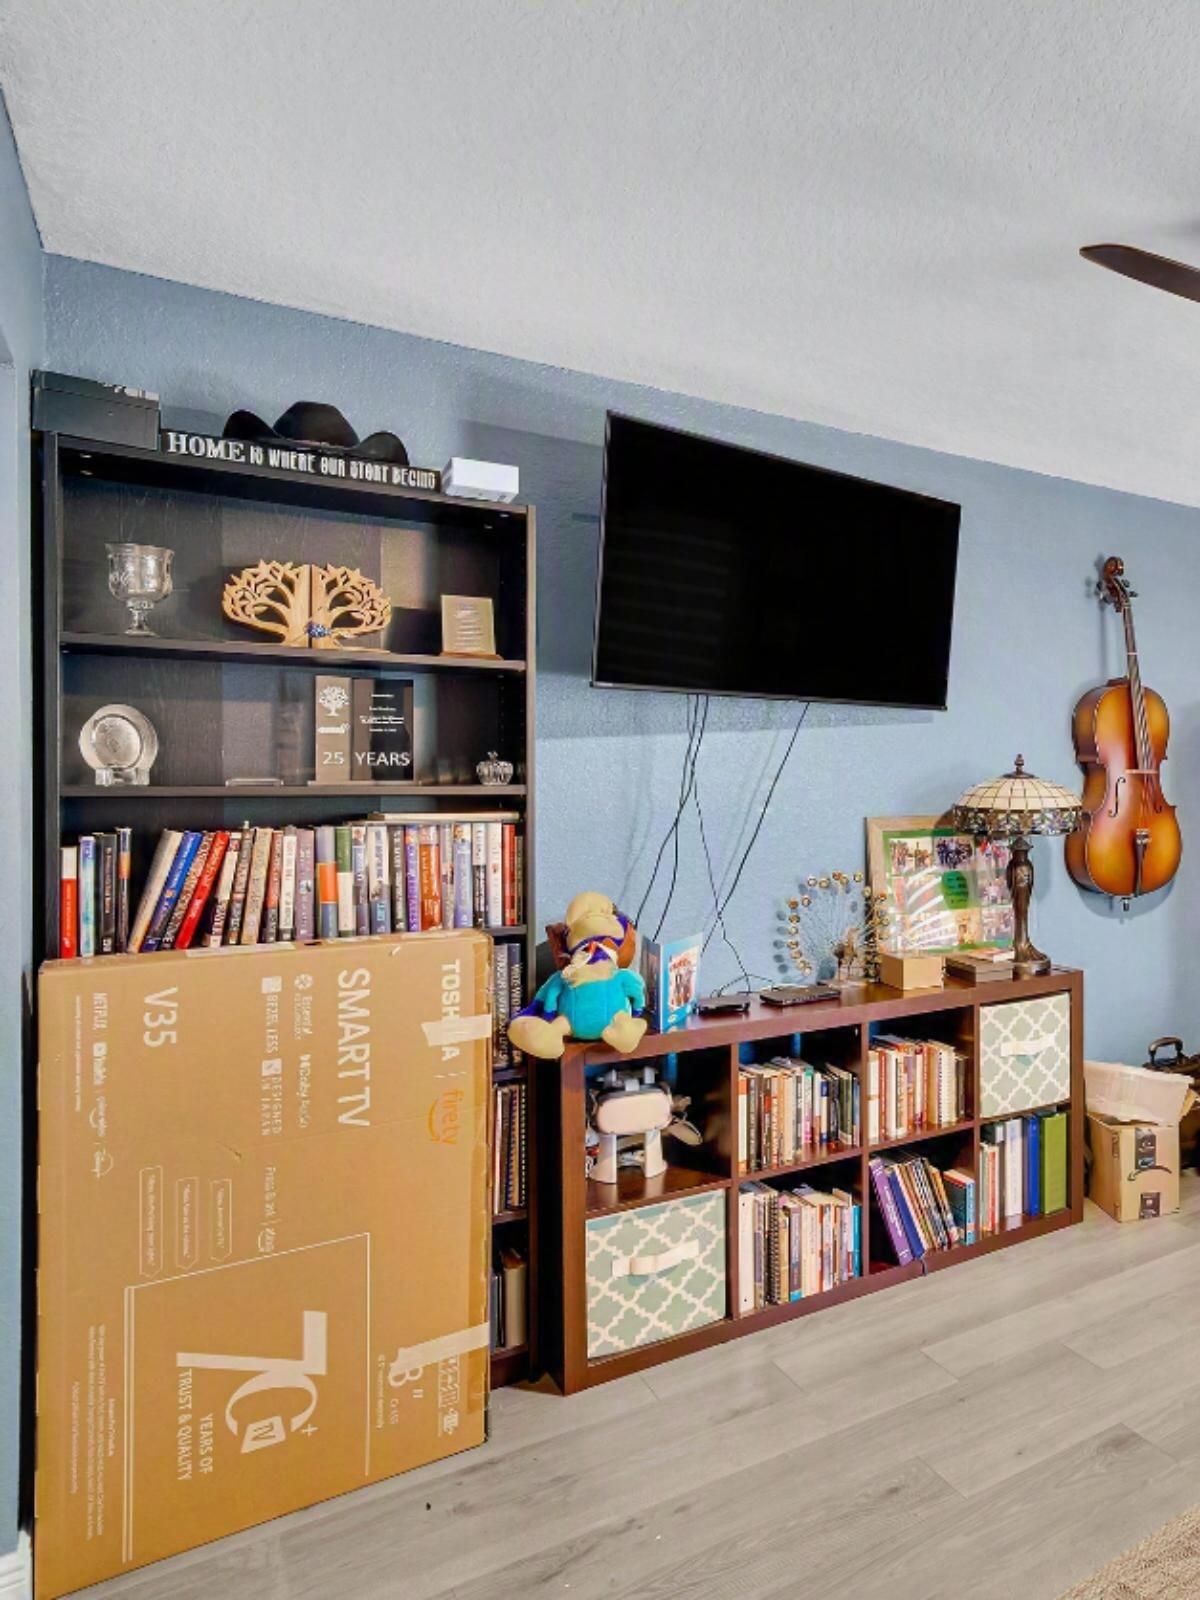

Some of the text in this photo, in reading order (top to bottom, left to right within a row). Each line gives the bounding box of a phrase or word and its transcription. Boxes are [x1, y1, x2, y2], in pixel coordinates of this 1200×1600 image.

[167, 431, 246, 463] HOME
[268, 447, 316, 474] WHERE
[321, 457, 346, 477] OUR
[322, 751, 410, 766] 25 YEARS
[143, 987, 178, 1048] V35
[441, 959, 461, 1061] TOSHA
[265, 1029, 279, 1054] LESS
[337, 968, 370, 1127] SMART TV
[261, 1097, 271, 1136] JAPAN
[271, 1076, 282, 1135] DESIGNED
[177, 1368, 192, 1480] TRUST & QUALITY
[199, 1413, 214, 1474] YEARS OF
